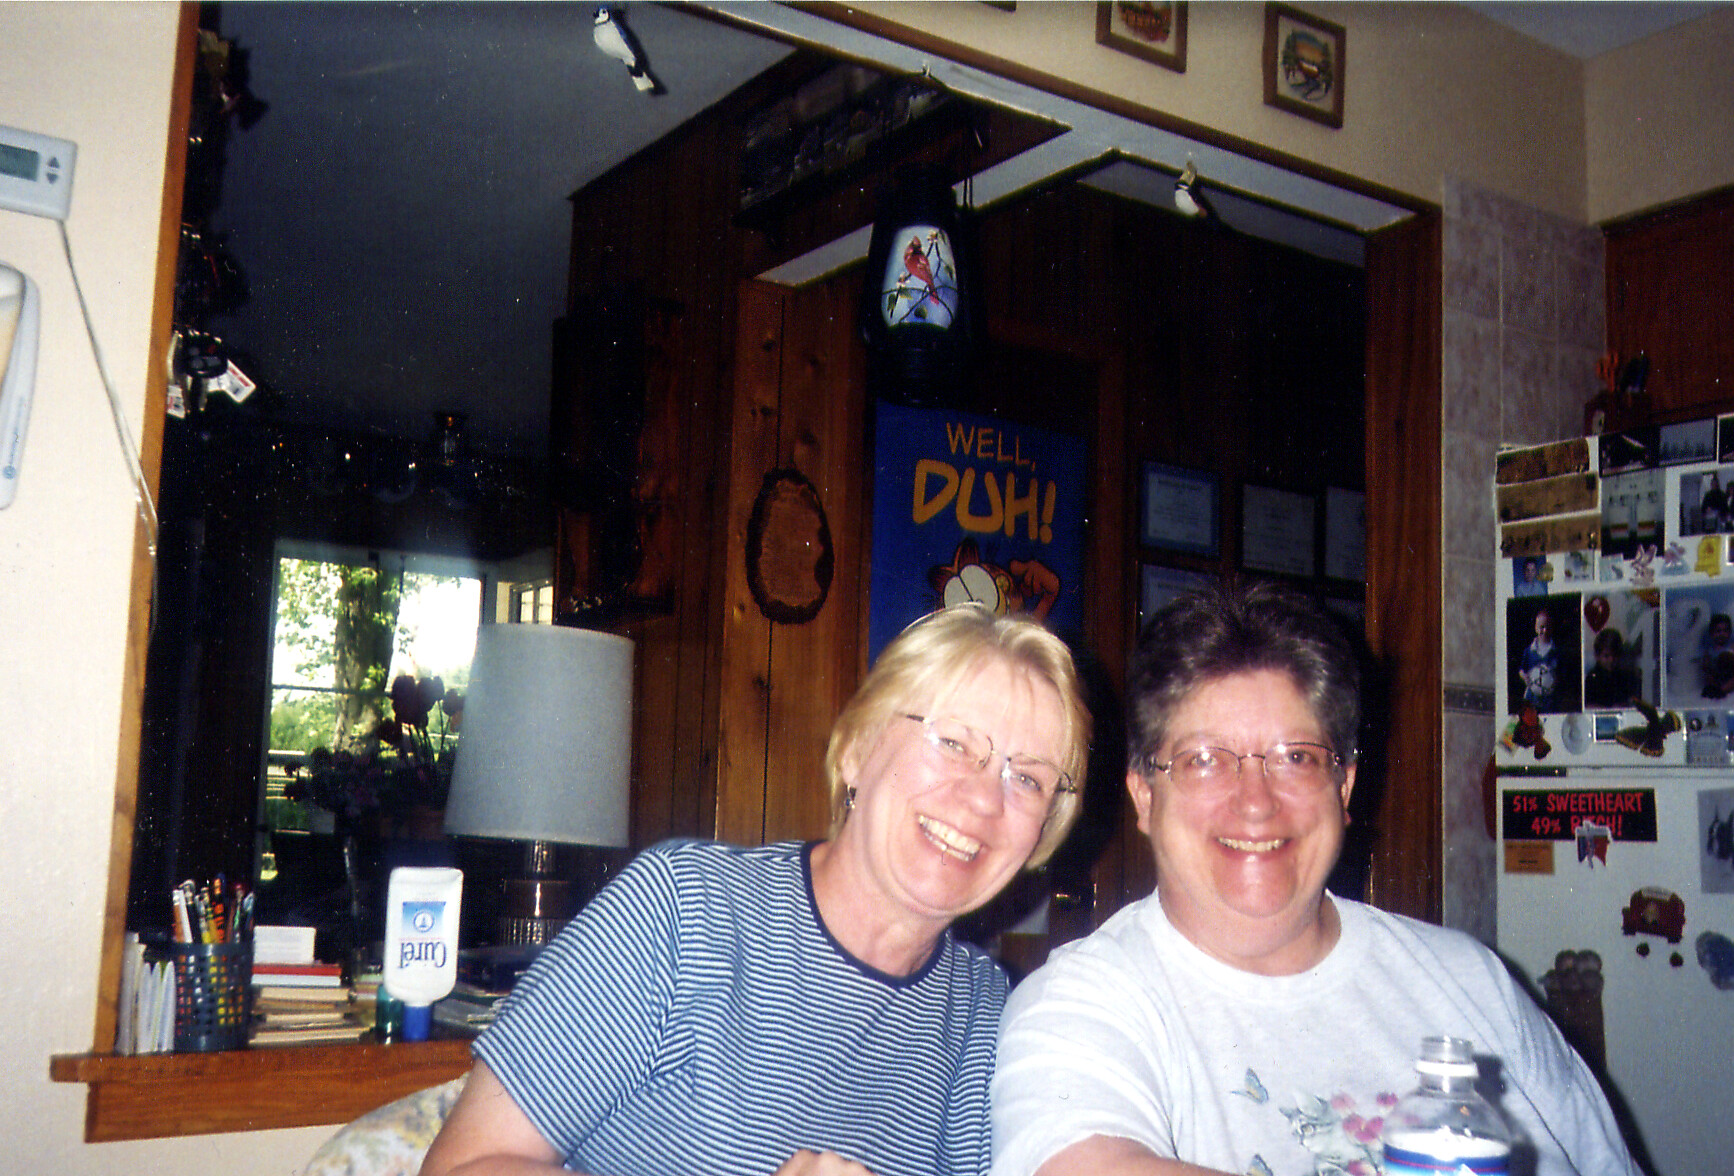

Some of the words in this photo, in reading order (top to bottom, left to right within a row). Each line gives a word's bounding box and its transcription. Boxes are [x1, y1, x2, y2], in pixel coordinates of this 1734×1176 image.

[946, 422, 1036, 472] WELL,
[912, 458, 1057, 544] DUH!
[1512, 795, 1538, 813] 51%
[1546, 792, 1644, 813] SWEETHEART
[1531, 816, 1561, 836] 49%
[1570, 814, 1623, 837] BCH!
